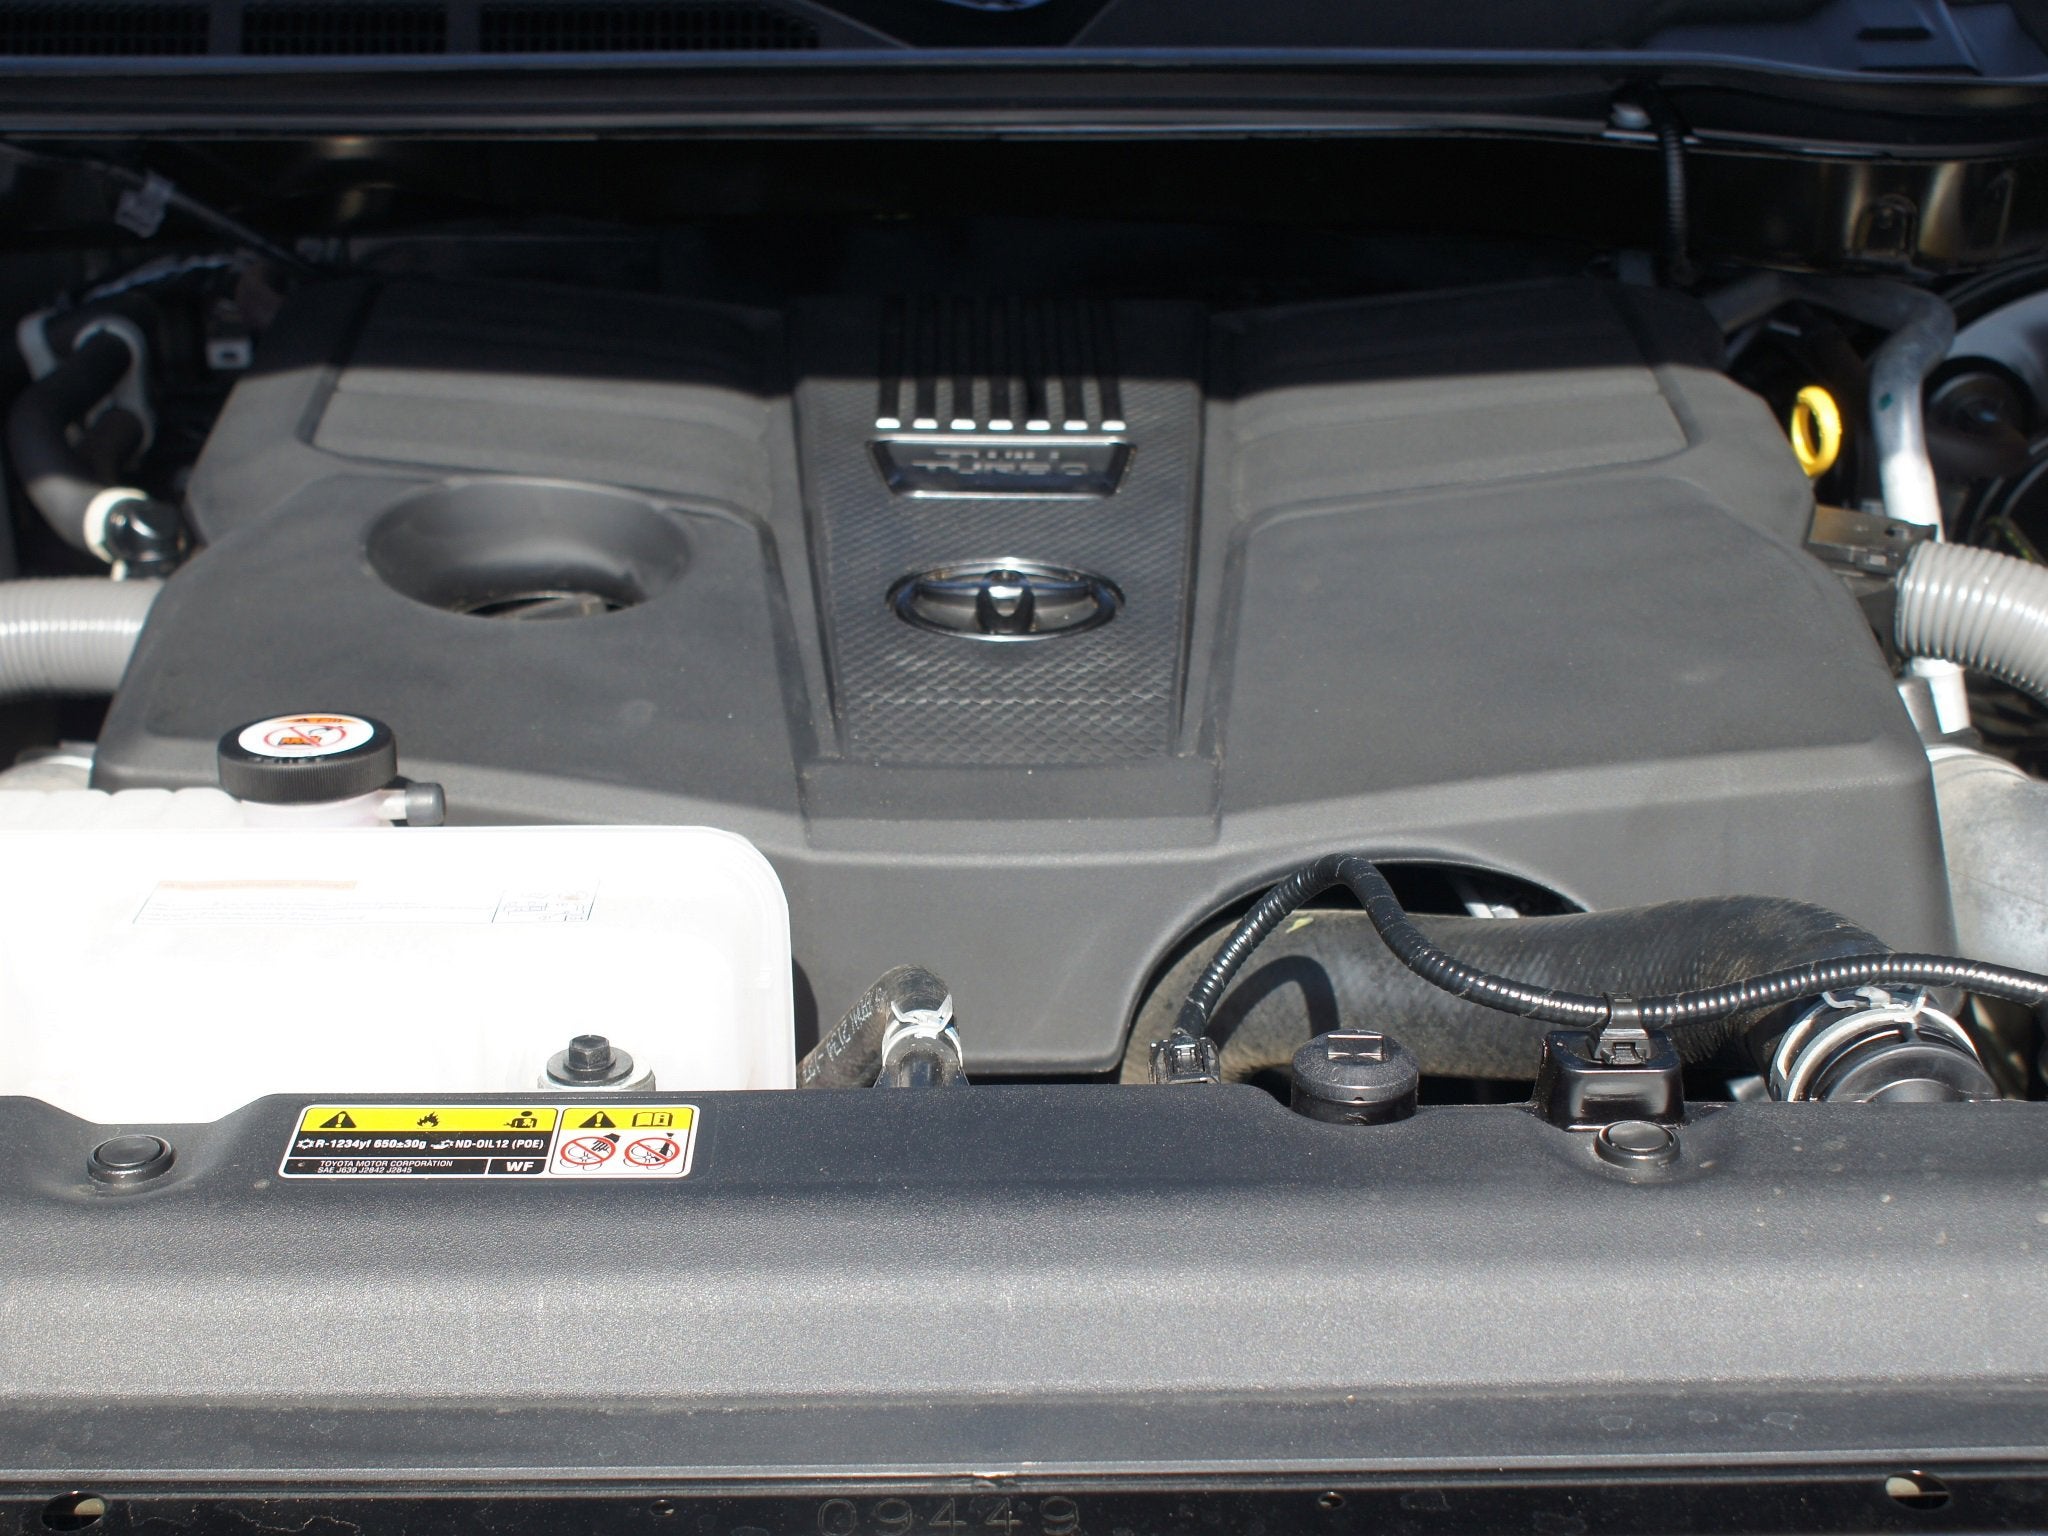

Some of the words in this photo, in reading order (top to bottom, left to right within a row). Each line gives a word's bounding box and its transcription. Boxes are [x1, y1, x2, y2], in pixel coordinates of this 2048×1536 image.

[314, 1139, 371, 1150] R-1234yf
[373, 1139, 427, 1150] 650±30g
[454, 1139, 509, 1149] ND-OIL12
[511, 1139, 544, 1150] (POE)
[317, 1166, 334, 1174] SAE
[335, 1166, 357, 1174] J639
[359, 1166, 385, 1174] J2842
[386, 1166, 412, 1174] J2845
[506, 1161, 534, 1172] WF
[816, 1496, 1080, 1536] 09449
